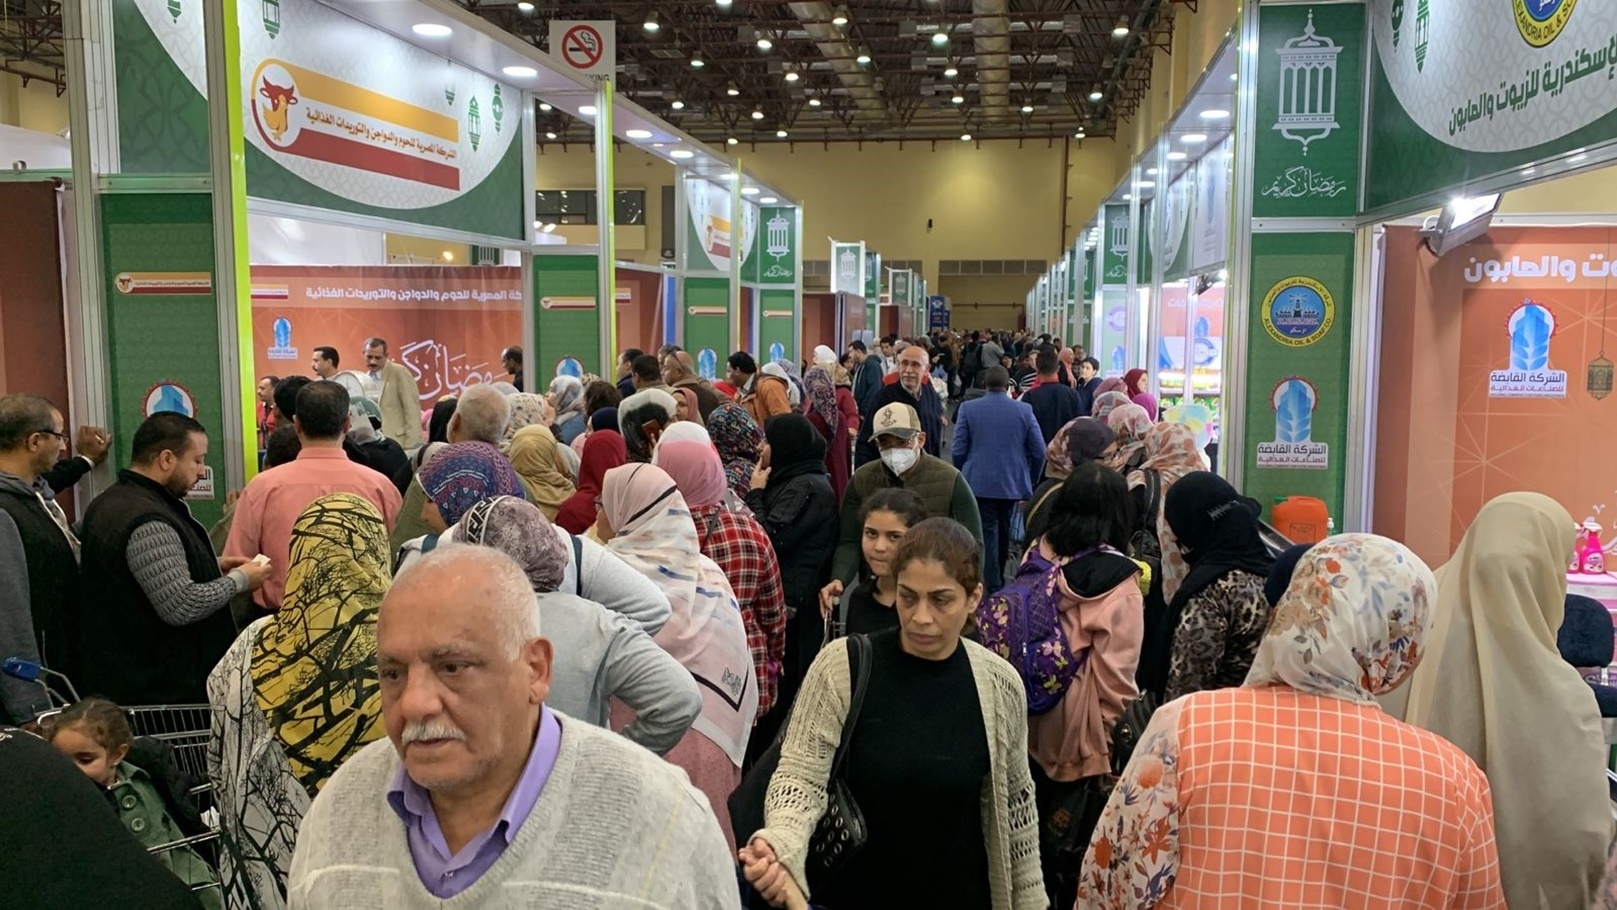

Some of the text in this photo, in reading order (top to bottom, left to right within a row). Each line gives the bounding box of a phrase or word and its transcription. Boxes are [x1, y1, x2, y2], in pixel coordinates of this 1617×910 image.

[1515, 0, 1542, 40] EXANDRIA
[1543, 22, 1556, 39] OIL
[1556, 14, 1563, 28] &
[1449, 33, 1617, 136] لإسكندرية للزيوت والصابون
[1464, 255, 1577, 283] والصابون
[306, 286, 344, 299] الغذائية
[345, 287, 397, 300] والتوريدات
[398, 289, 440, 301] والدواجن
[440, 290, 470, 301] للحوم
[471, 290, 507, 302] المصرية
[1264, 318, 1294, 345] ALEXANDRIA
[1311, 327, 1325, 341] SOAP
[1490, 372, 1565, 386] الشركة القابضة
[1258, 444, 1327, 457] الشركة القابضة
